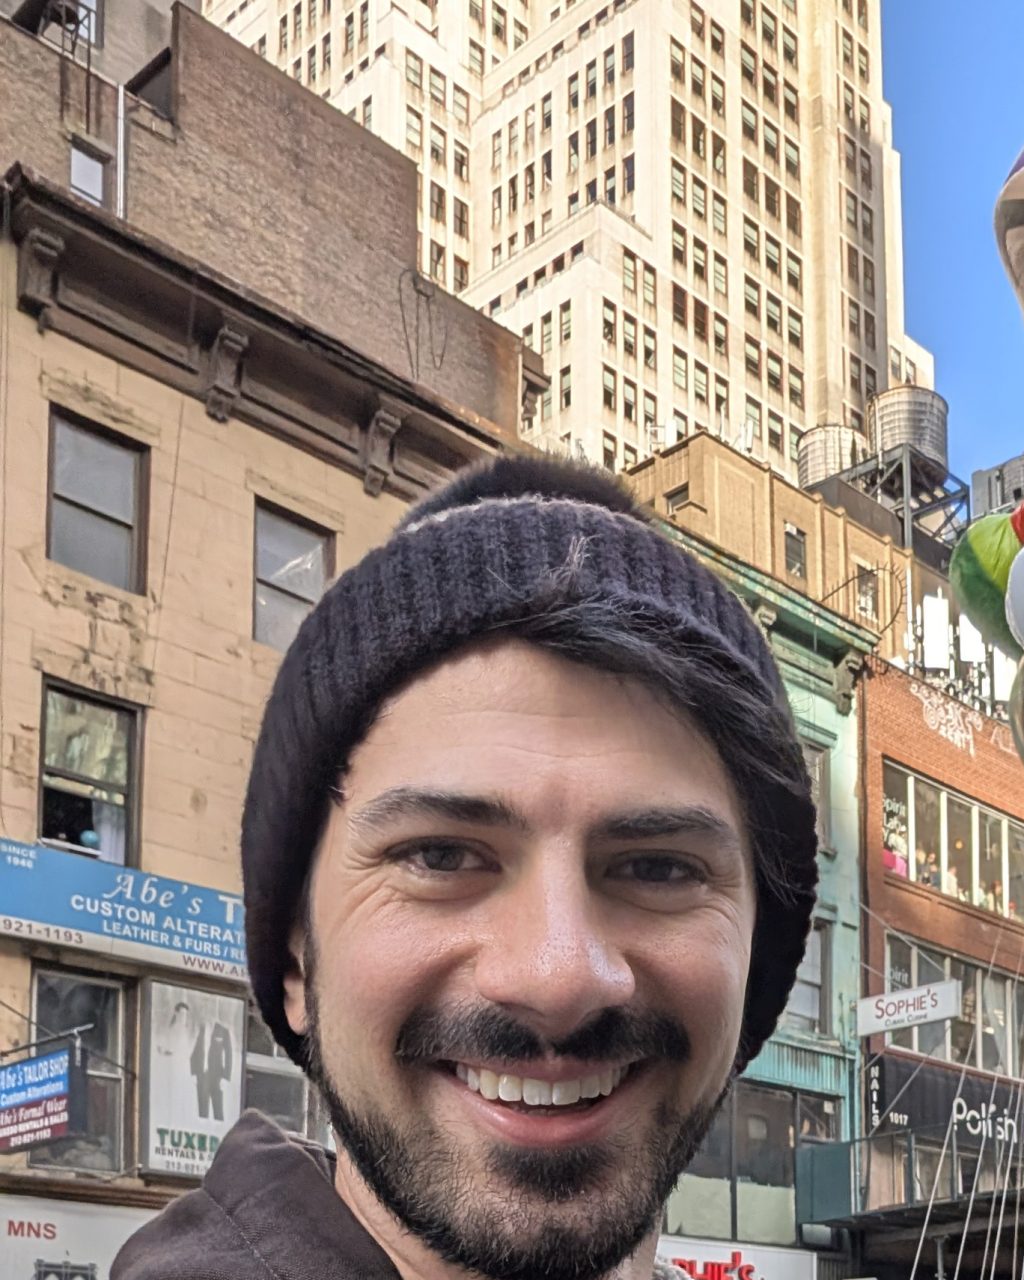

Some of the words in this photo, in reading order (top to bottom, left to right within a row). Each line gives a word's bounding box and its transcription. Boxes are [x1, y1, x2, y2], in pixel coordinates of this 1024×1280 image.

[0, 843, 37, 859] SINCE
[102, 873, 203, 916] Abe's
[2, 918, 84, 945] 921-1193
[71, 894, 156, 926] CUSTOM
[163, 915, 244, 945] ALTERAT
[103, 919, 169, 944] LEATHER
[172, 934, 182, 948] &
[185, 937, 221, 956] FURS
[869, 1065, 880, 1128] NAILS
[952, 1097, 1018, 1144] Polish
[154, 1146, 196, 1160] RENTALS
[7, 1219, 57, 1240] MNS
